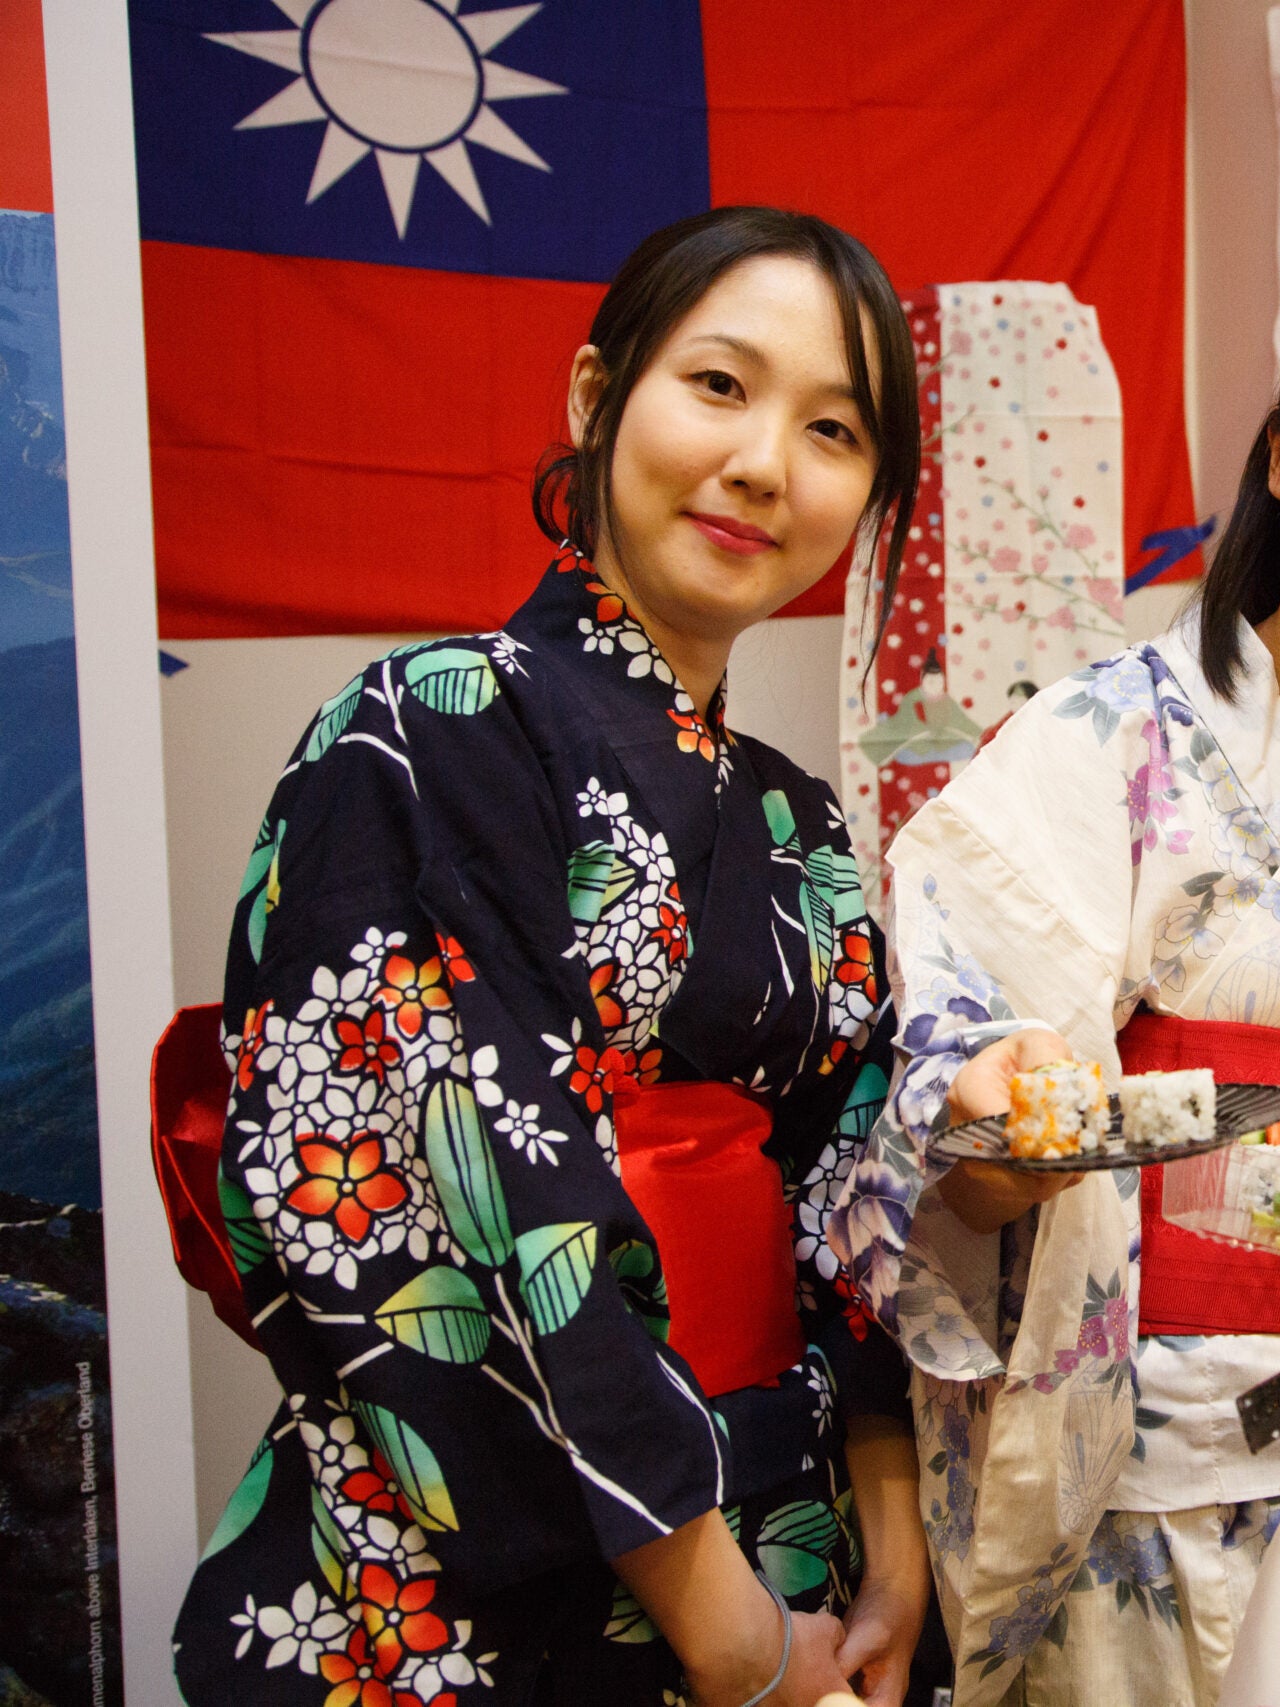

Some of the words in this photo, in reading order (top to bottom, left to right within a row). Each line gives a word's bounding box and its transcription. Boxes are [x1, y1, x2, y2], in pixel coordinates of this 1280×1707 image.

[76, 1361, 94, 1429] Oberland
[80, 1432, 97, 1493] Bernese
[82, 1495, 100, 1572] Interlaken,
[86, 1573, 102, 1617] above
